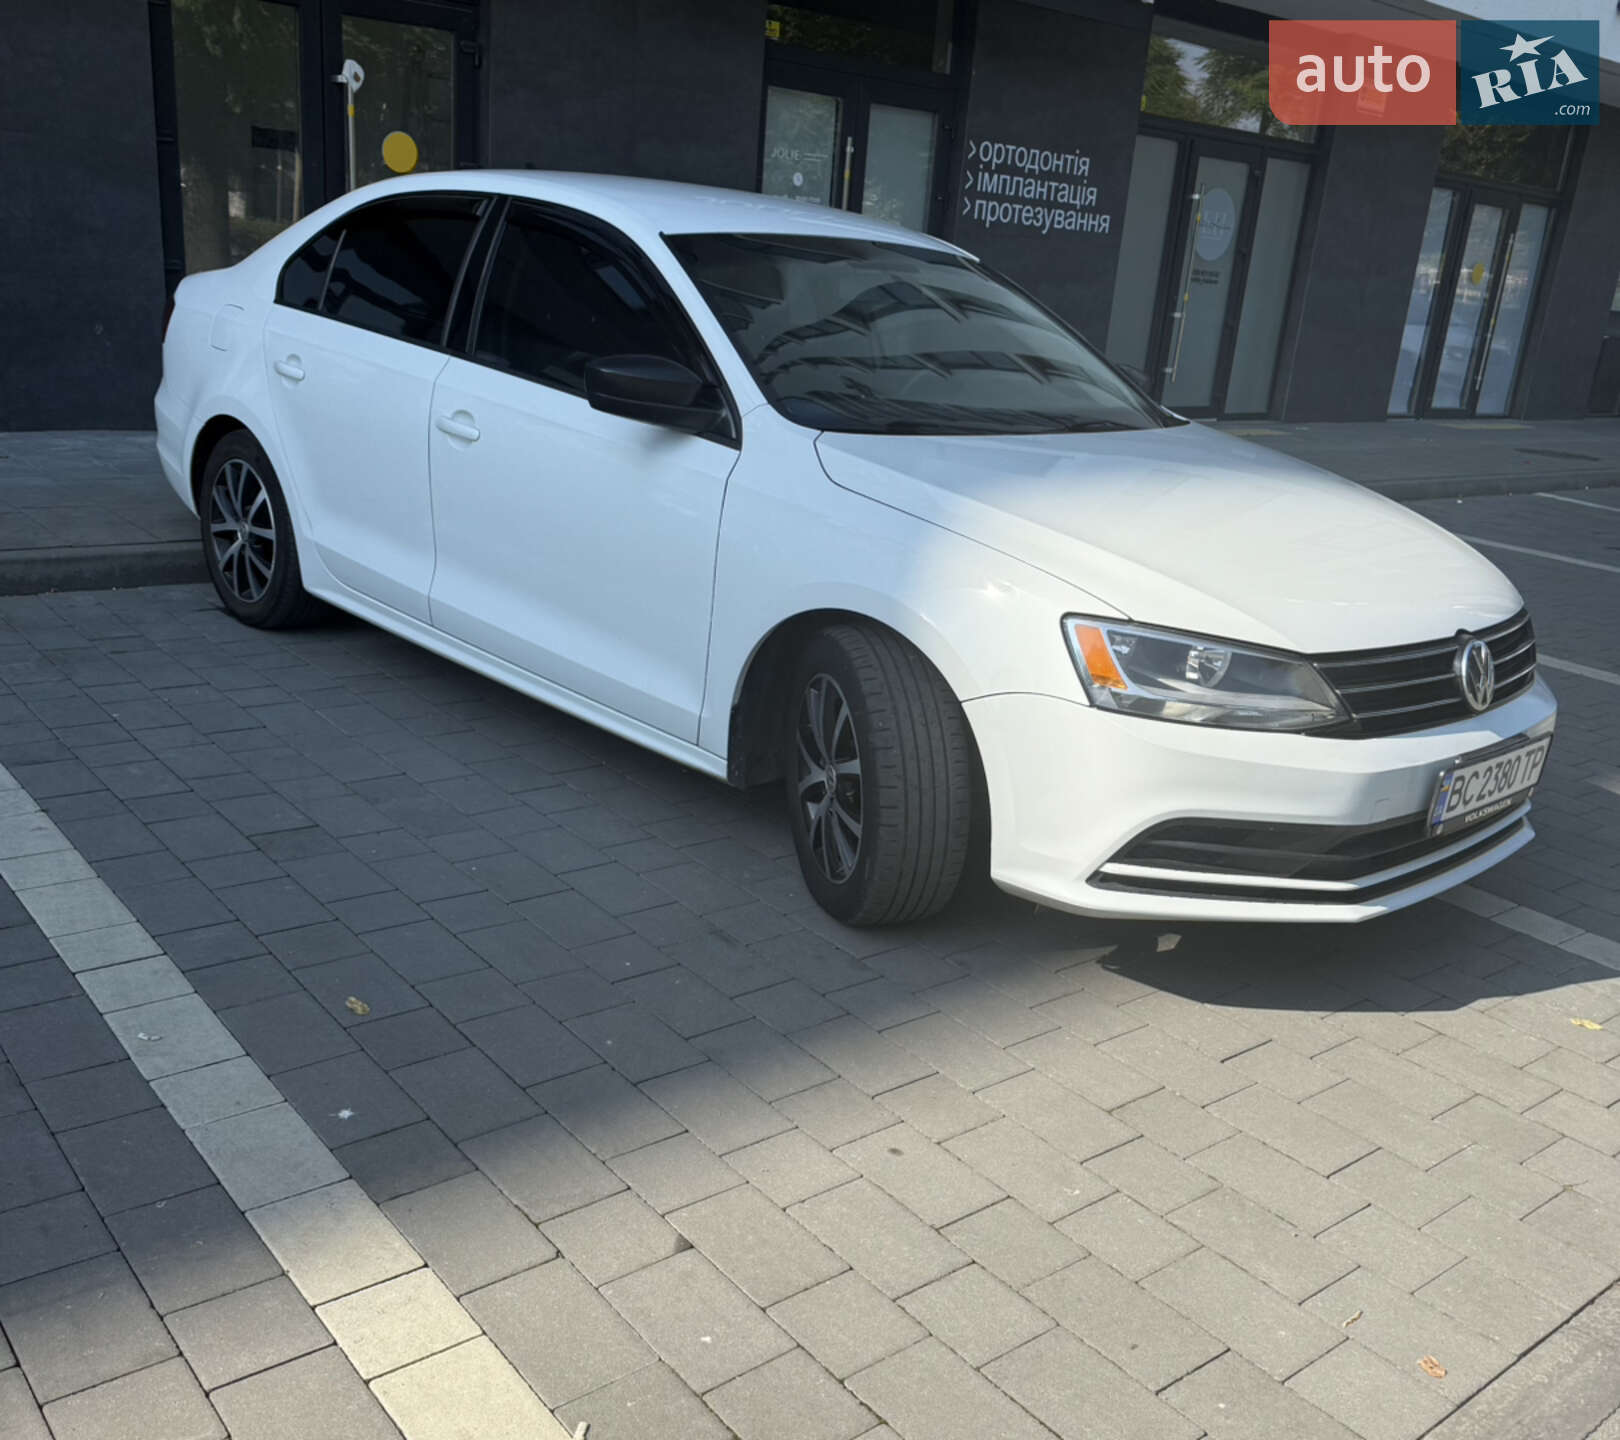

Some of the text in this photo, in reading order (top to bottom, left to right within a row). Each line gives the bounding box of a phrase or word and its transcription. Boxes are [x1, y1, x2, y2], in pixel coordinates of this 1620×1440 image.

[979, 140, 1090, 177] ортодонтія
[976, 164, 1097, 209] імплантація
[973, 199, 1111, 234] протезування
[1446, 770, 1479, 813] BC
[1476, 755, 1521, 801] 2380
